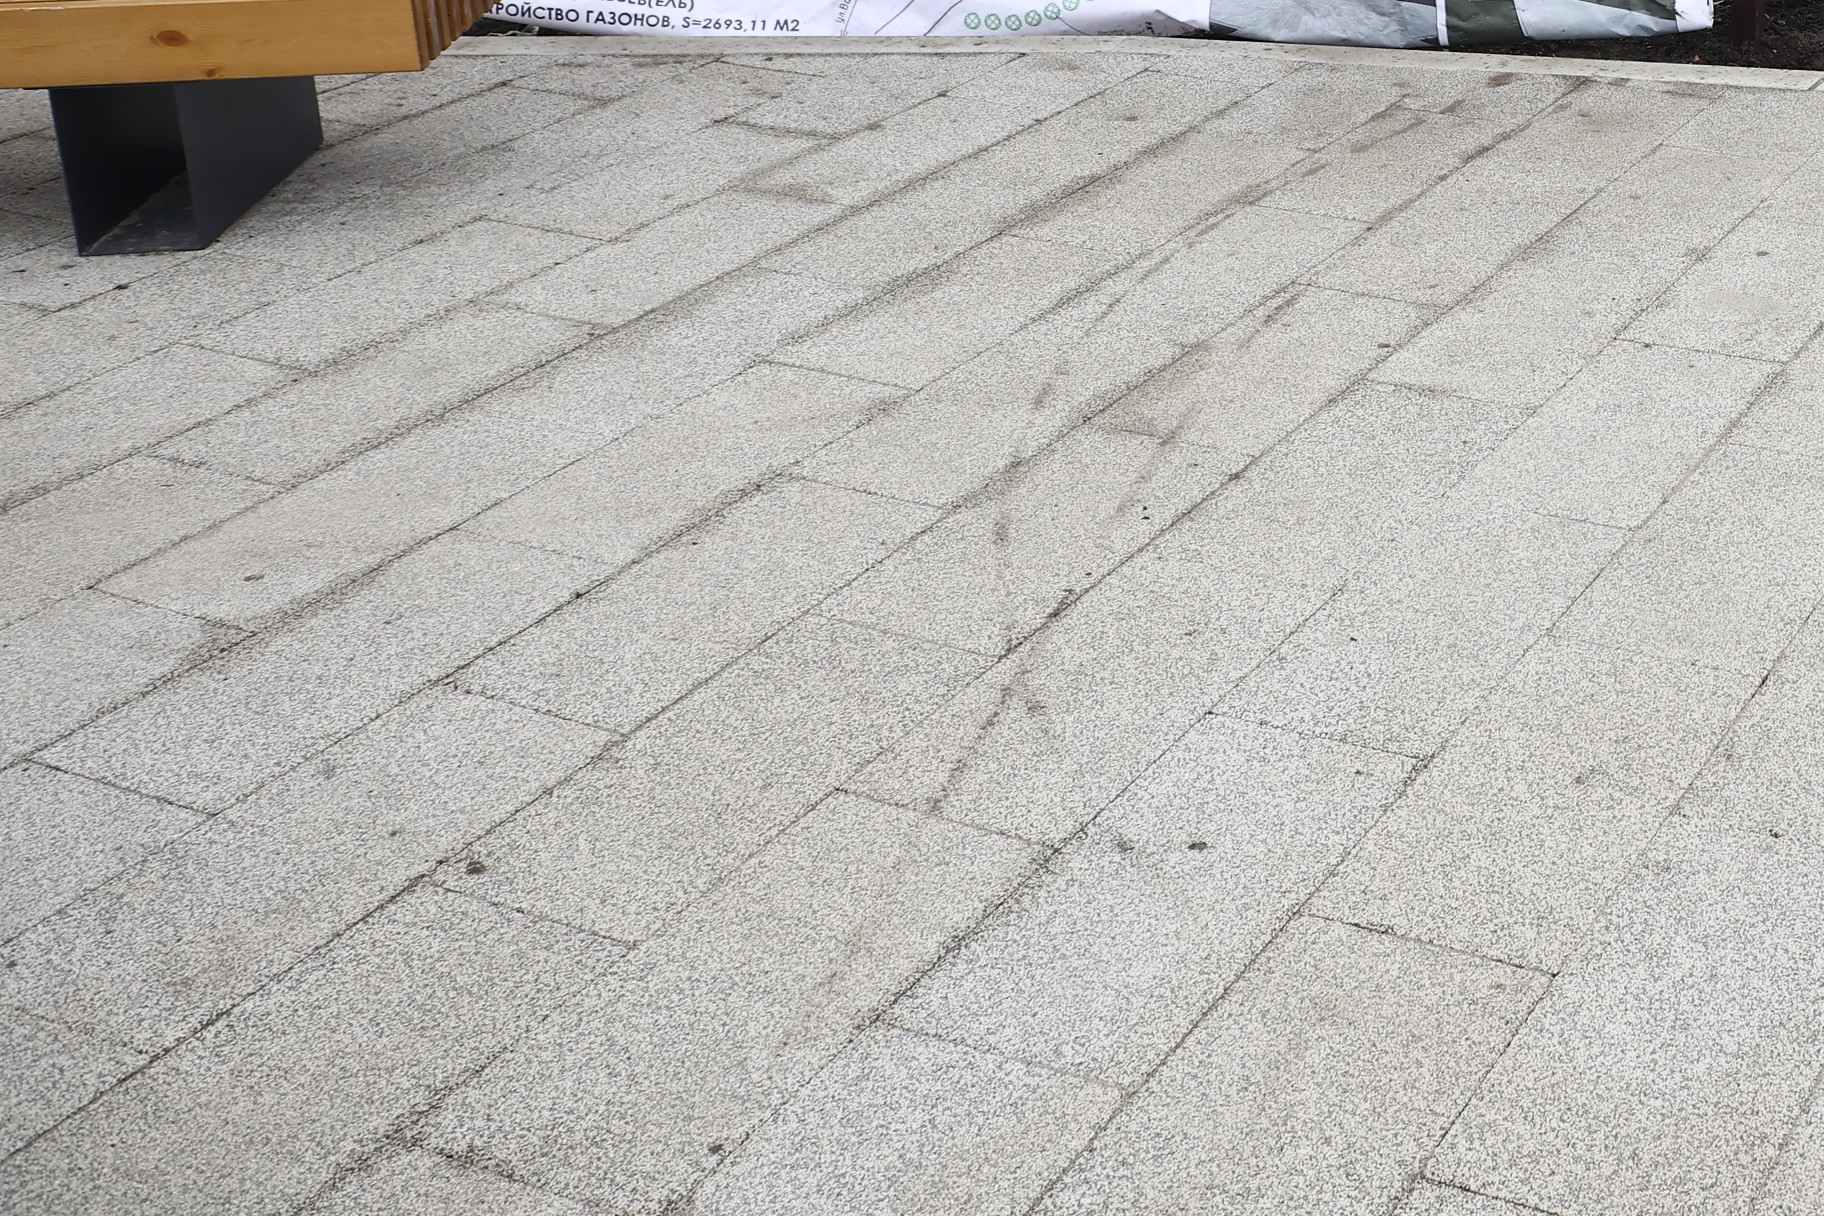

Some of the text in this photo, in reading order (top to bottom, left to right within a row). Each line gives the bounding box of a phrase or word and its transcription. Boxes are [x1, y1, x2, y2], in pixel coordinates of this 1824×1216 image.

[584, 6, 676, 31] ГАЗОНОВ,
[682, 11, 766, 31] S=2693,11
[774, 19, 799, 31] М2
